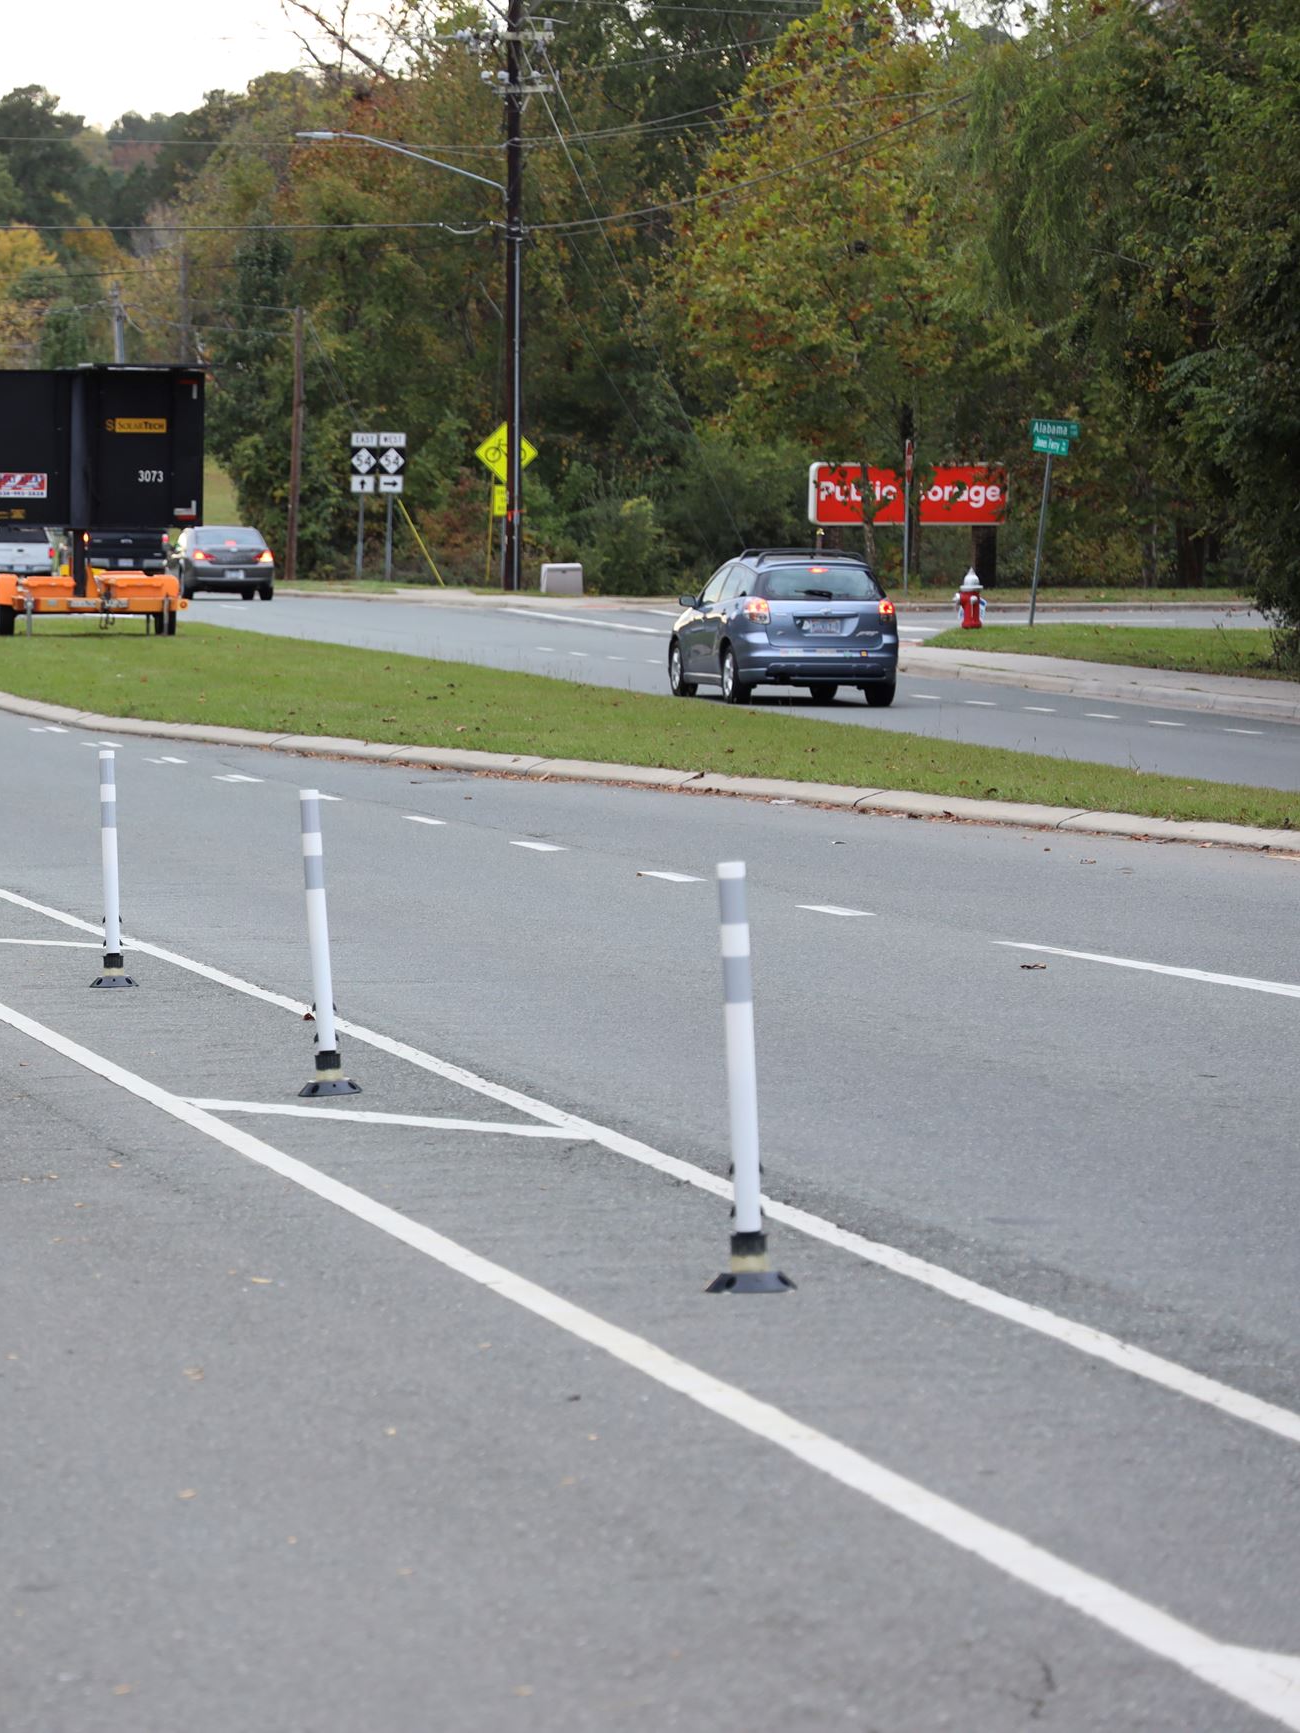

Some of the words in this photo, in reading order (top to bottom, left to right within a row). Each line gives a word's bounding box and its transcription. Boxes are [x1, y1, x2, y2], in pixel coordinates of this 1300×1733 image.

[1033, 421, 1068, 436] Alabama
[355, 435, 374, 444] EAST
[383, 435, 402, 444] WEST
[356, 454, 372, 468] 54
[384, 454, 400, 468] 54
[138, 469, 164, 482] 3073
[819, 480, 897, 501] Pubic
[919, 482, 1002, 508] orage
